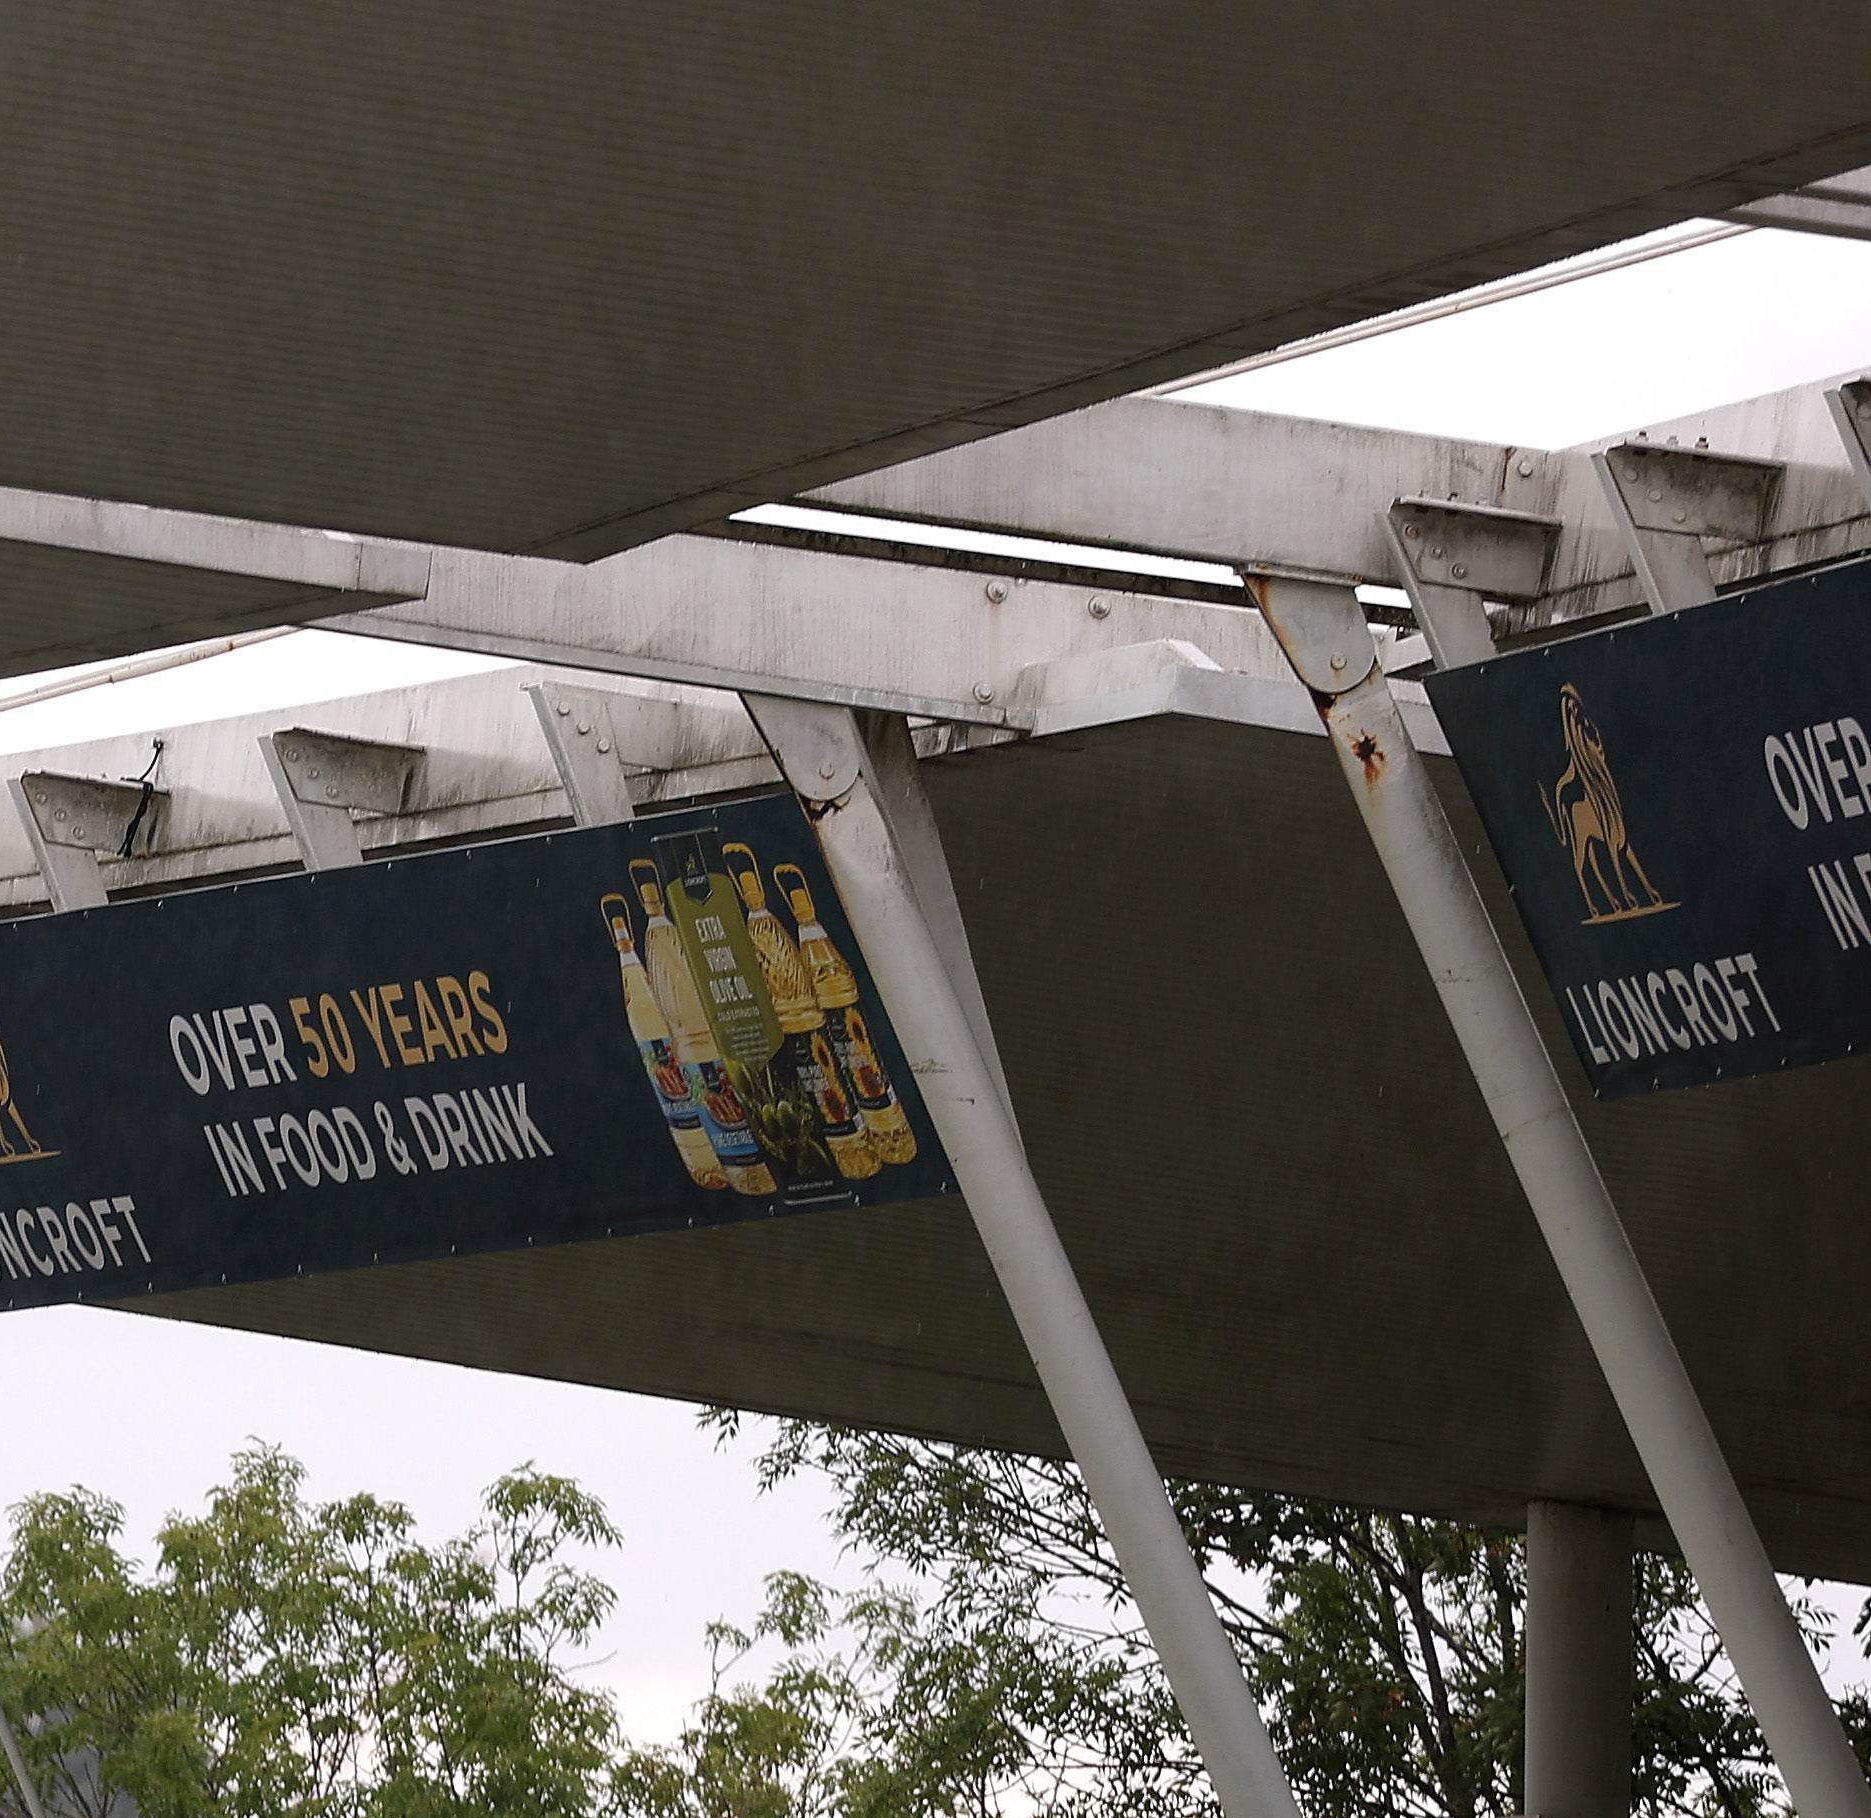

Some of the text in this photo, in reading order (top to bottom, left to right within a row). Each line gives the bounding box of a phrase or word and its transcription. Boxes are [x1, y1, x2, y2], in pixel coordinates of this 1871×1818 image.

[695, 915, 727, 943] EXTRA
[169, 971, 509, 1096] OVER 50 YEARS
[1566, 953, 1781, 1065] LIONCROFT
[203, 1082, 555, 1198] IN FOOD & DRINK
